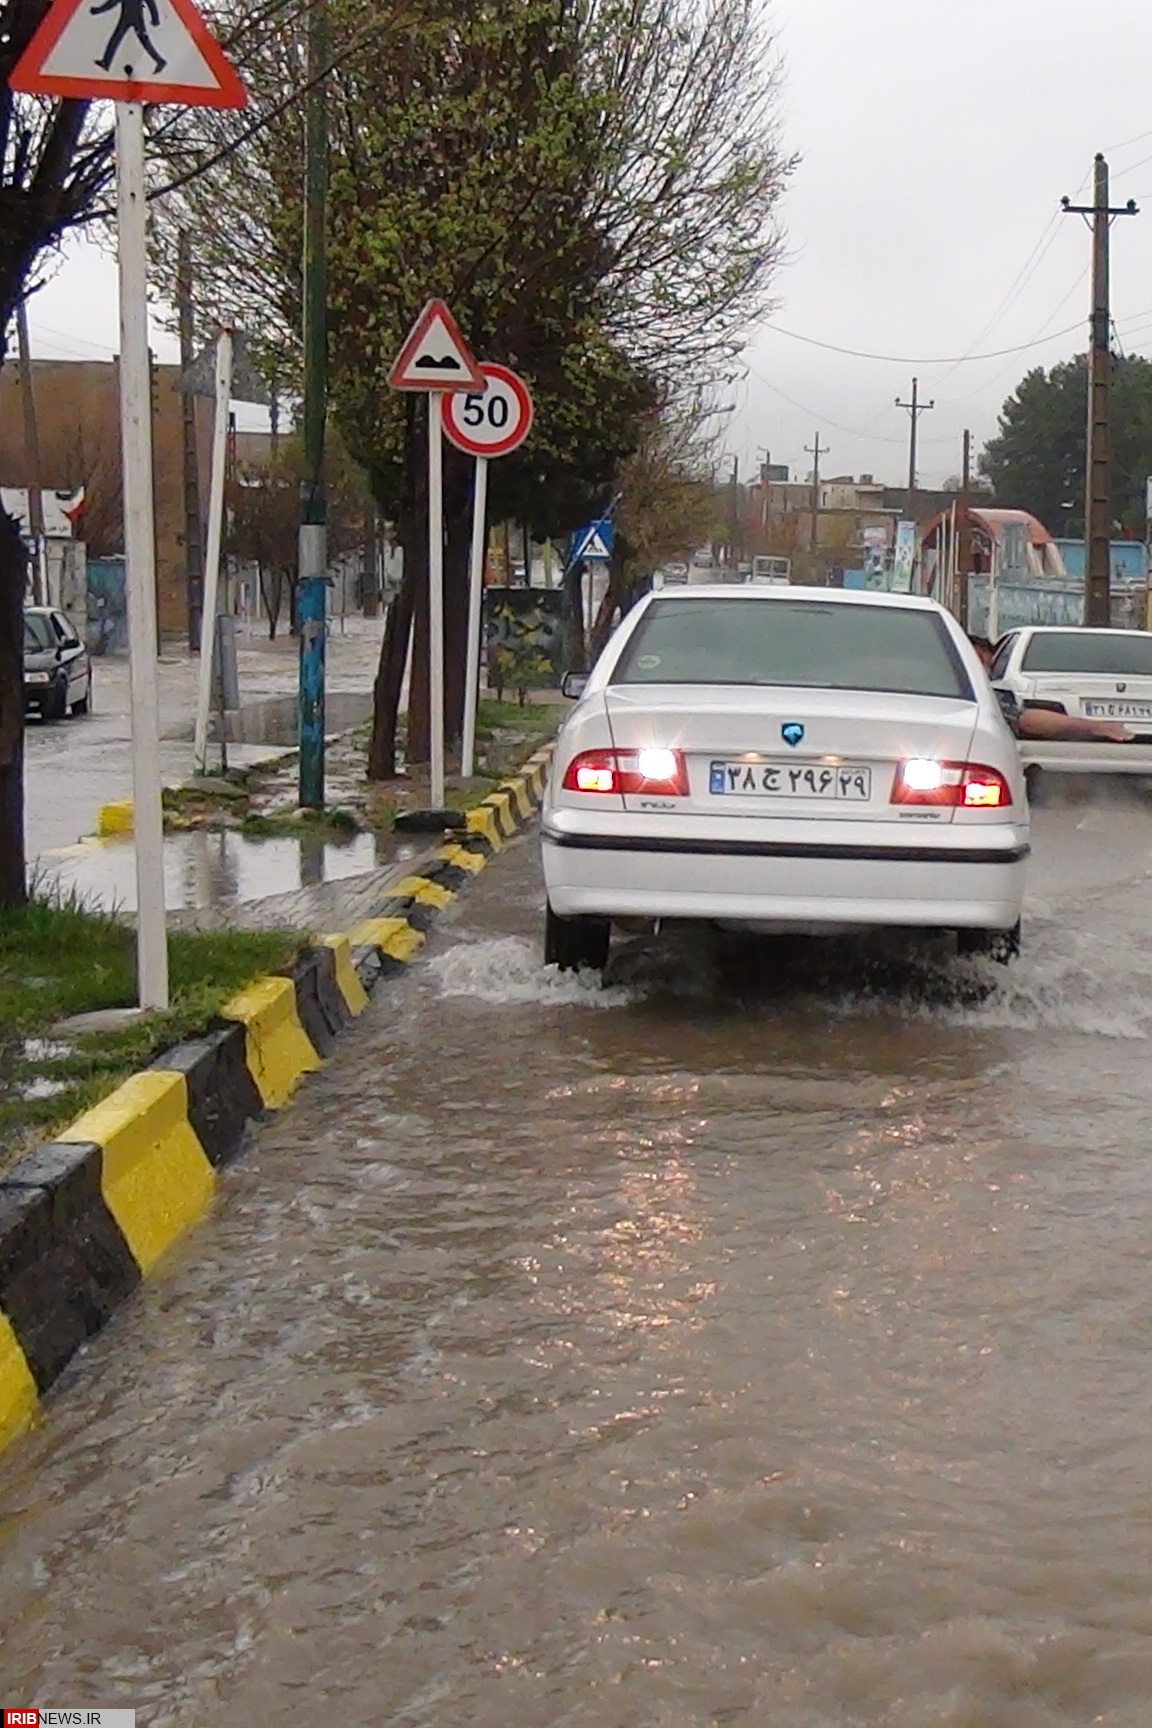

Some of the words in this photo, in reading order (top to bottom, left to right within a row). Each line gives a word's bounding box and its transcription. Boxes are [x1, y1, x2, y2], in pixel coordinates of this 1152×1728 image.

[463, 393, 508, 428] 50
[727, 766, 756, 791] ۳۸
[762, 767, 782, 791] ج
[788, 768, 832, 794] ۲۹۶
[839, 775, 867, 798] ۲۹
